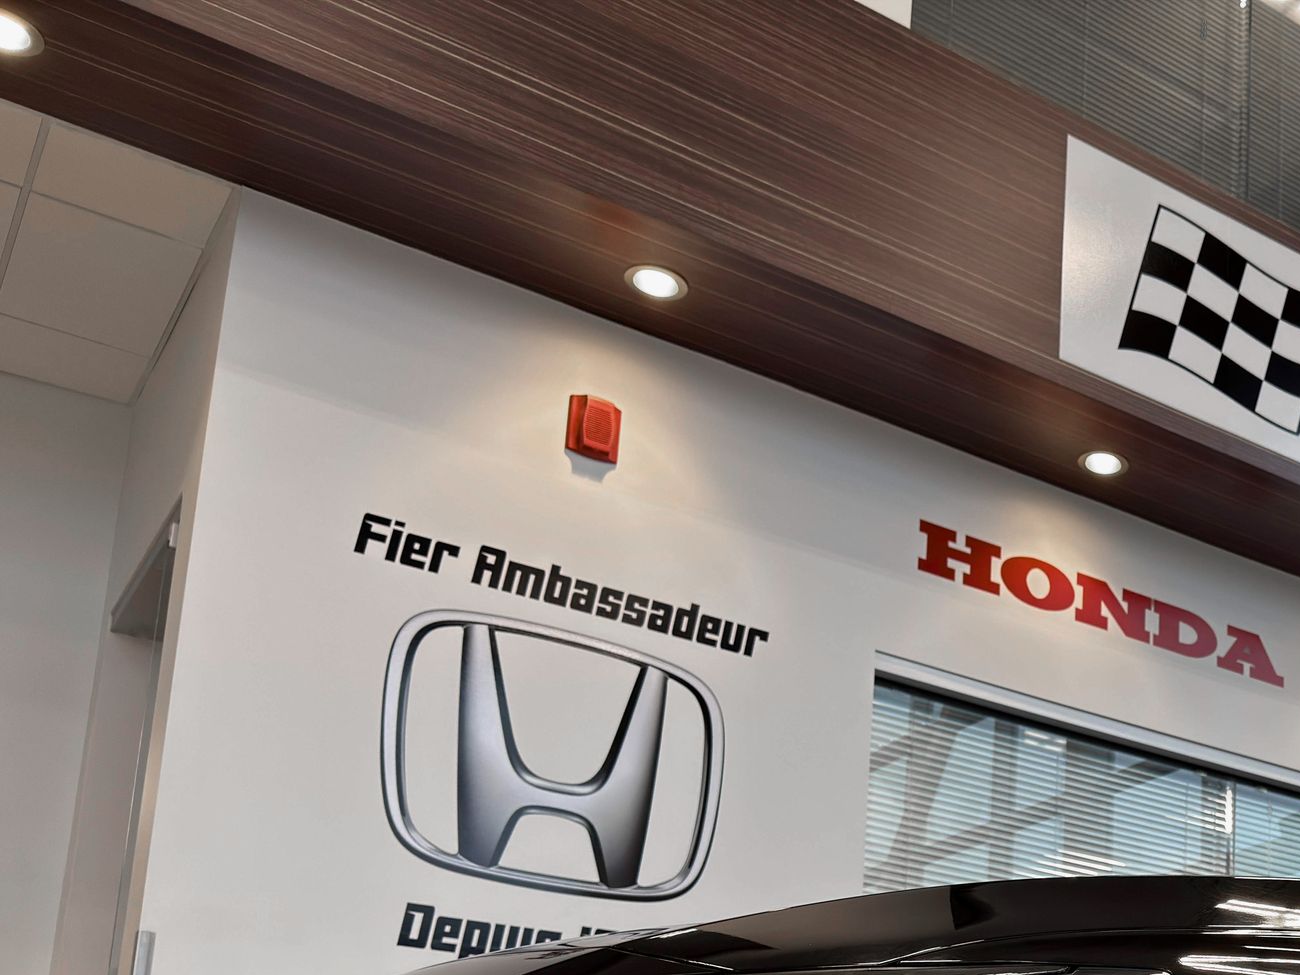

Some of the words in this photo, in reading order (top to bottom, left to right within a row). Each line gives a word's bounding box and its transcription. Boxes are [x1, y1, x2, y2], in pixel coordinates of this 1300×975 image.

[353, 512, 461, 574] Fier
[470, 544, 770, 658] Ambassadeur
[918, 520, 1285, 688] HONDA
